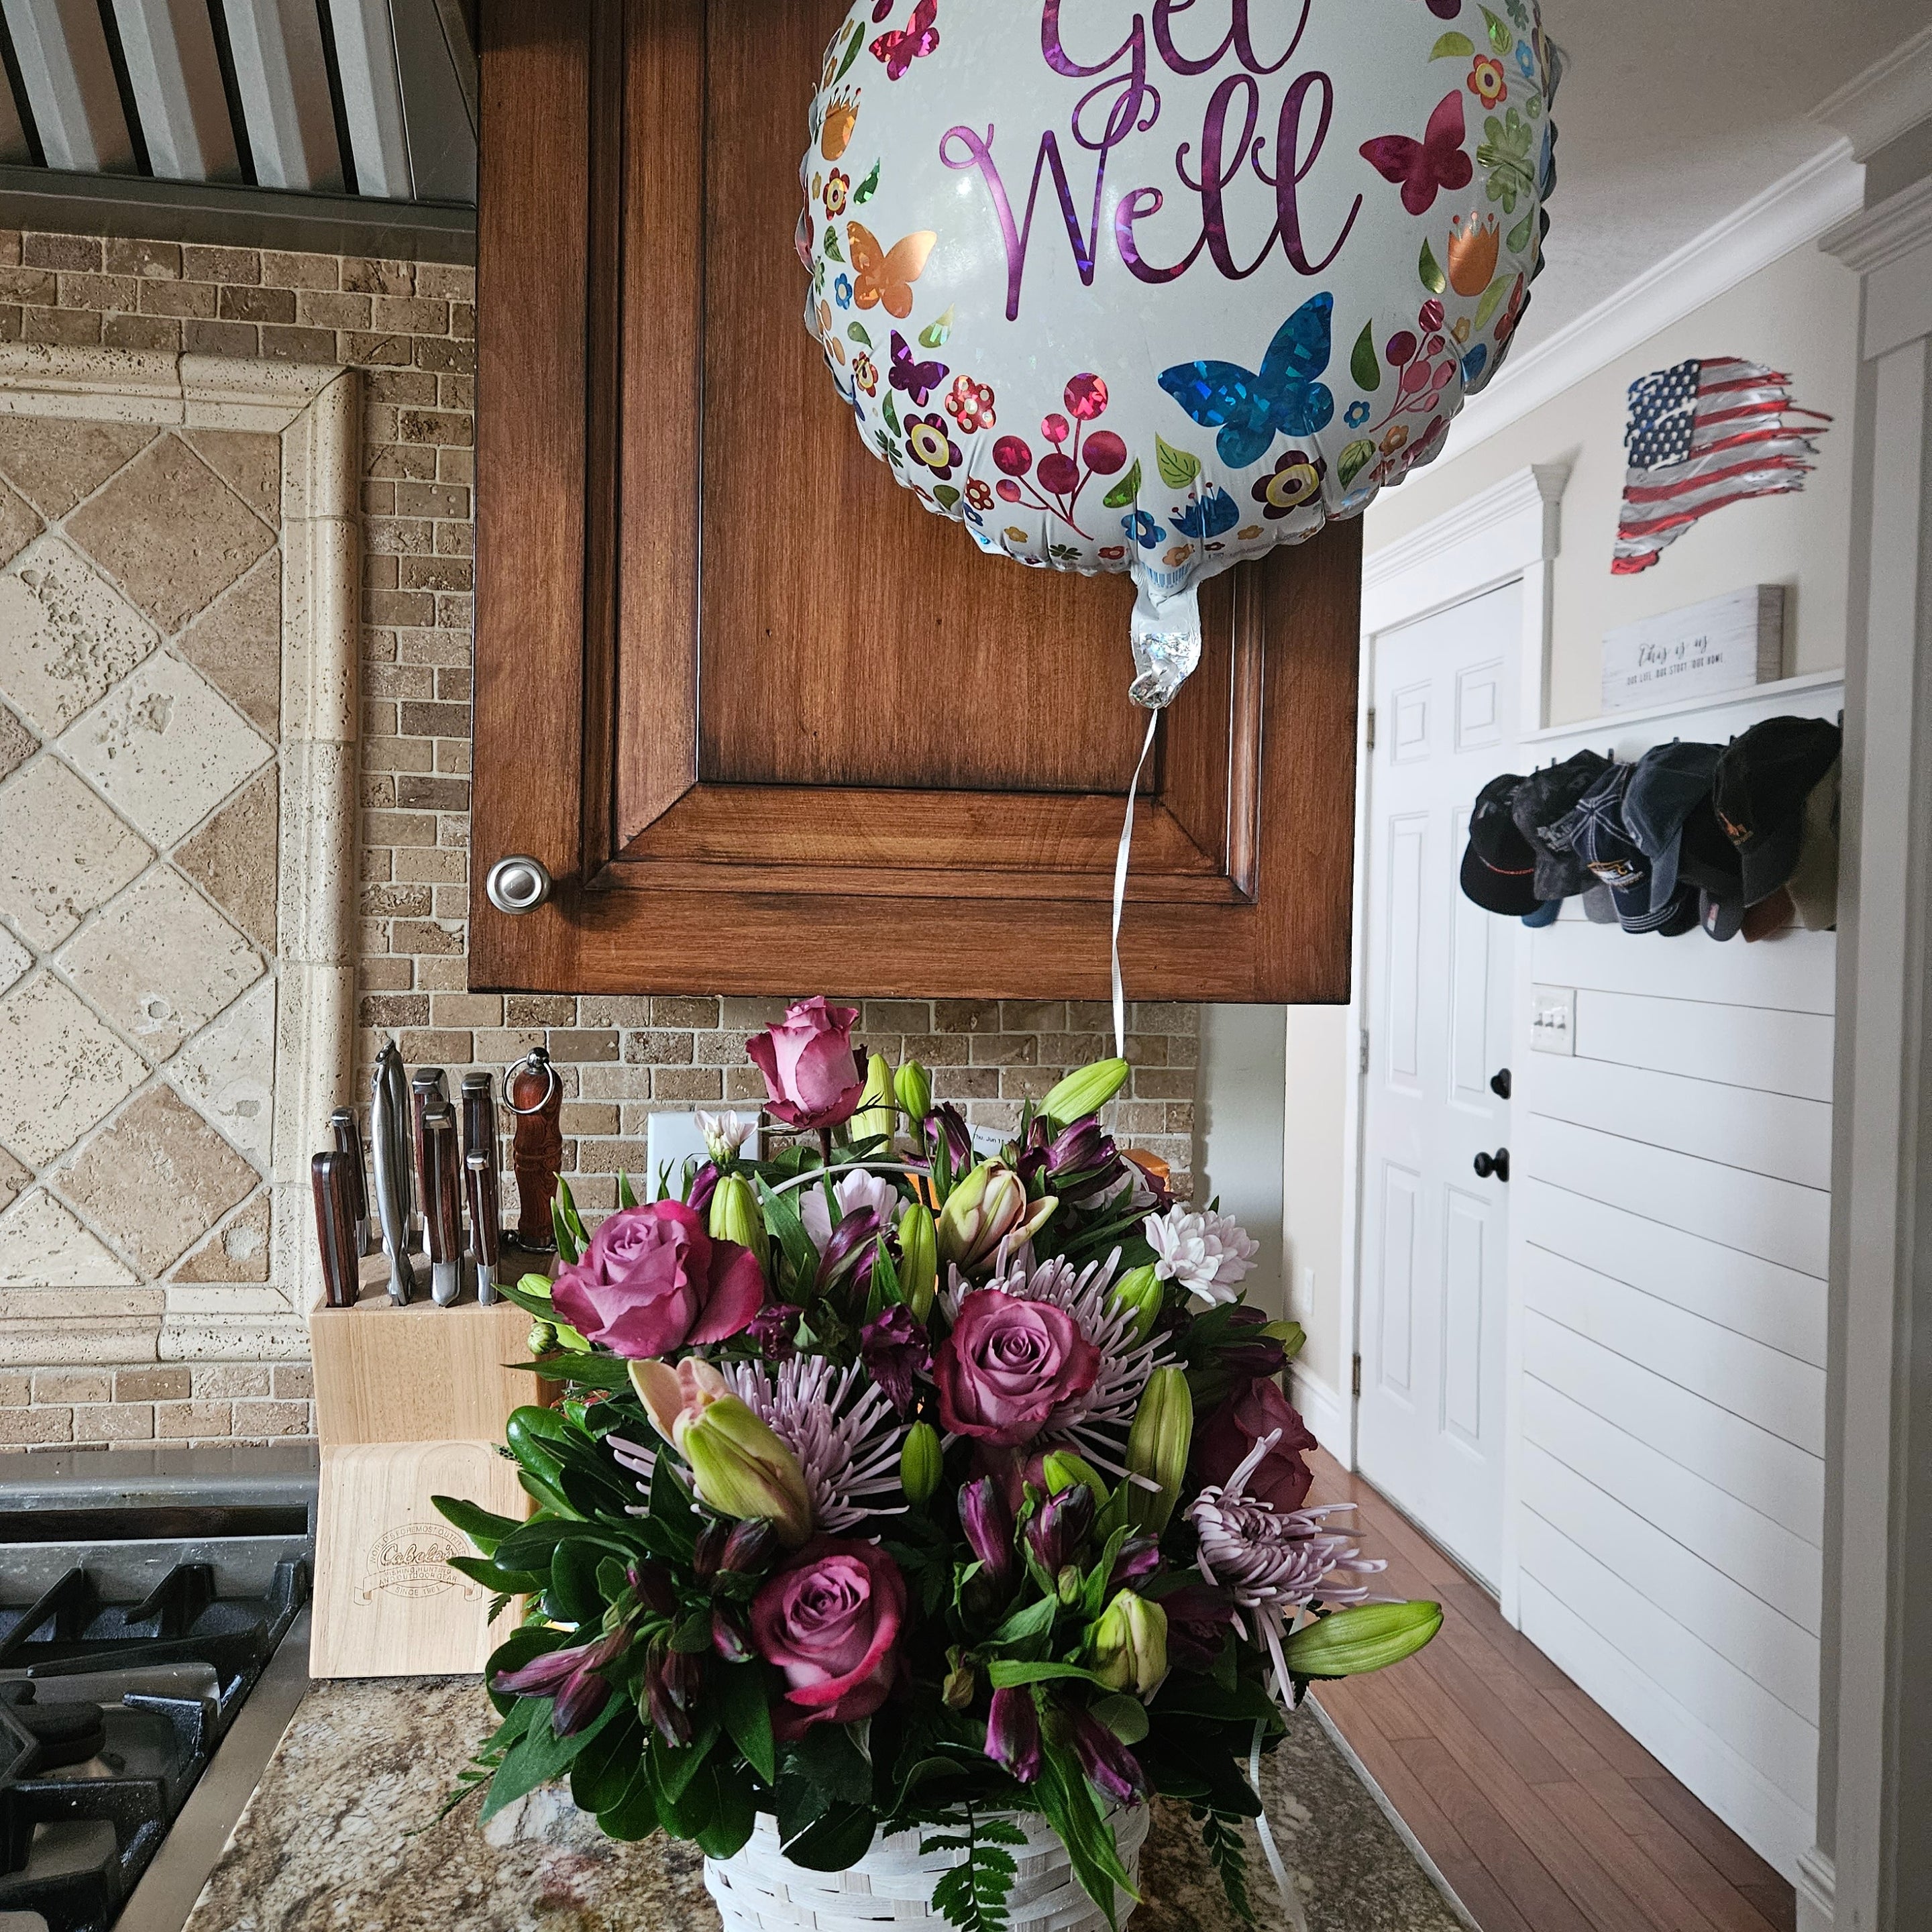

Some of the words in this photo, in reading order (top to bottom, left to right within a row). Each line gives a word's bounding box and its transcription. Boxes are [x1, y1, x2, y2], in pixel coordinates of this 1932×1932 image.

[938, 70, 1364, 322] Well
[1639, 643, 1667, 667] This
[370, 1533, 396, 1564] WORLD'S
[396, 1525, 437, 1537] FOREMOST
[438, 1527, 467, 1555] OUTFITTE
[380, 1542, 455, 1566] Cabela's
[378, 1576, 396, 1587] AND
[396, 1572, 435, 1582] OUTDOOR
[437, 1572, 458, 1583] GEAR
[418, 1566, 452, 1574] HUNTING
[394, 1586, 419, 1597] SINCE
